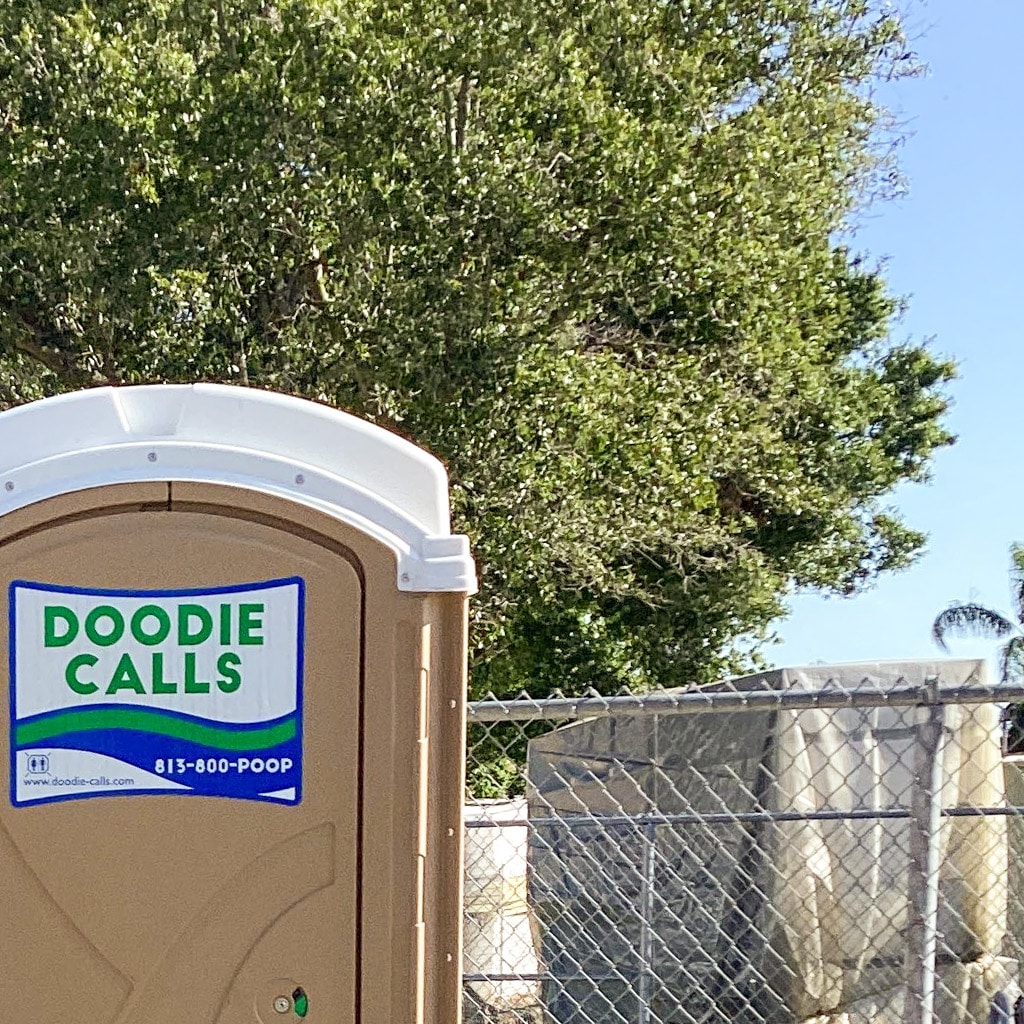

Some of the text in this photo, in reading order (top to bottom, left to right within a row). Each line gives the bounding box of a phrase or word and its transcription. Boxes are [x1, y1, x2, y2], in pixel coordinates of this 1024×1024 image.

[43, 603, 265, 648] DOODIE
[65, 652, 242, 695] CALLS
[155, 758, 293, 774] 813-800-POOP
[23, 776, 135, 786] www.doodie-calls.com
